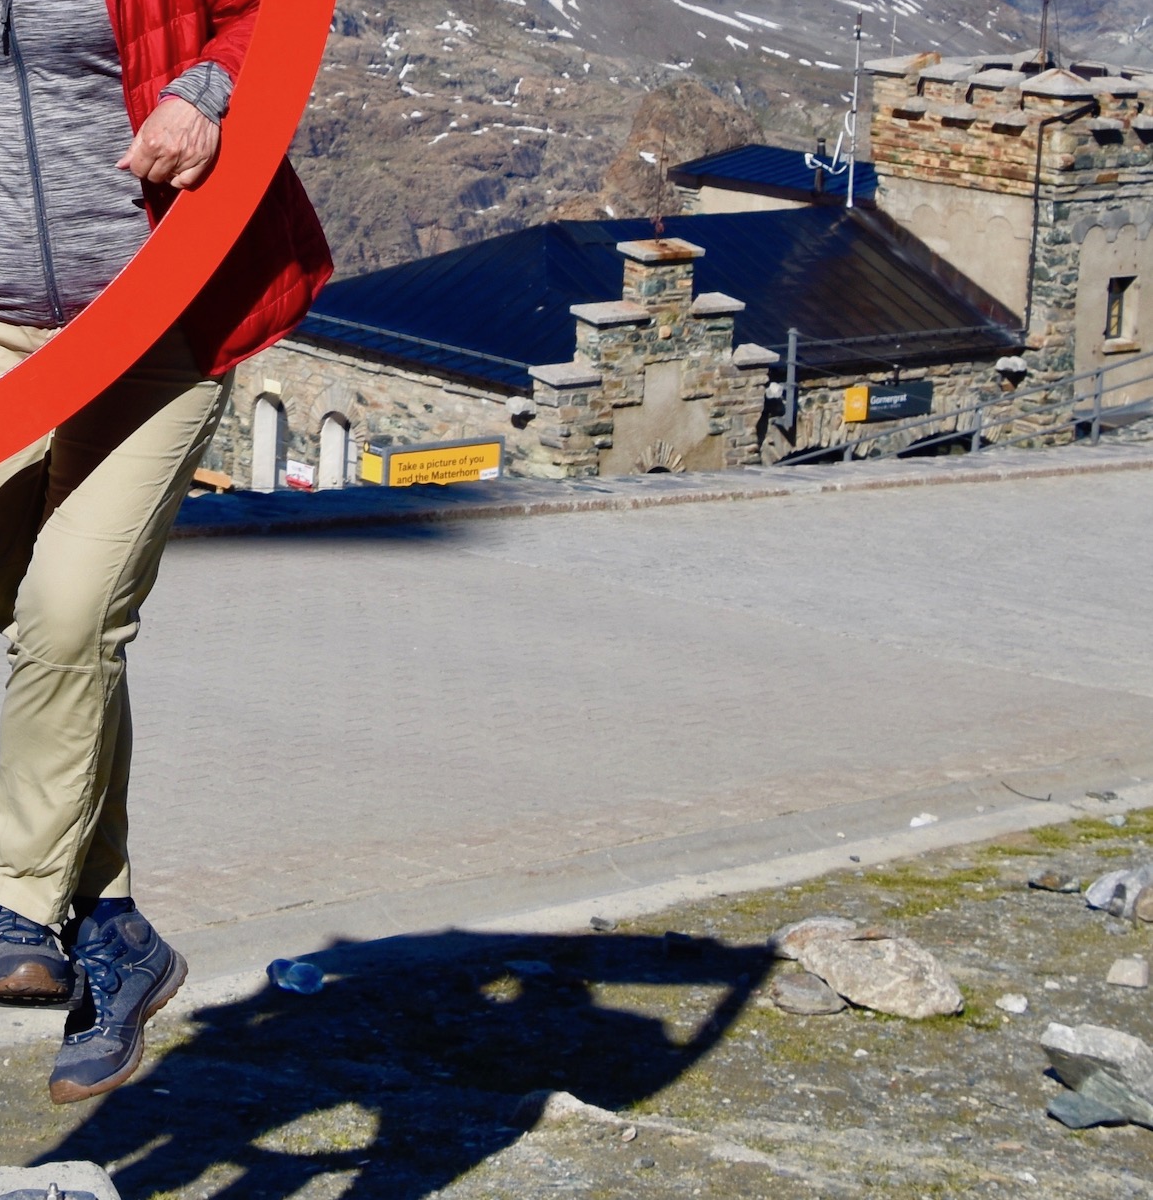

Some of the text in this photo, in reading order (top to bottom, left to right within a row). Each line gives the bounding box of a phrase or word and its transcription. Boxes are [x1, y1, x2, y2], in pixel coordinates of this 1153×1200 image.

[870, 393, 908, 404] Gornergrat
[398, 462, 417, 472] Take
[426, 458, 457, 471] picture
[459, 455, 468, 465] of
[469, 455, 485, 466] you
[396, 474, 413, 484] and
[415, 472, 429, 482] the
[431, 469, 479, 480] Matterhorn
